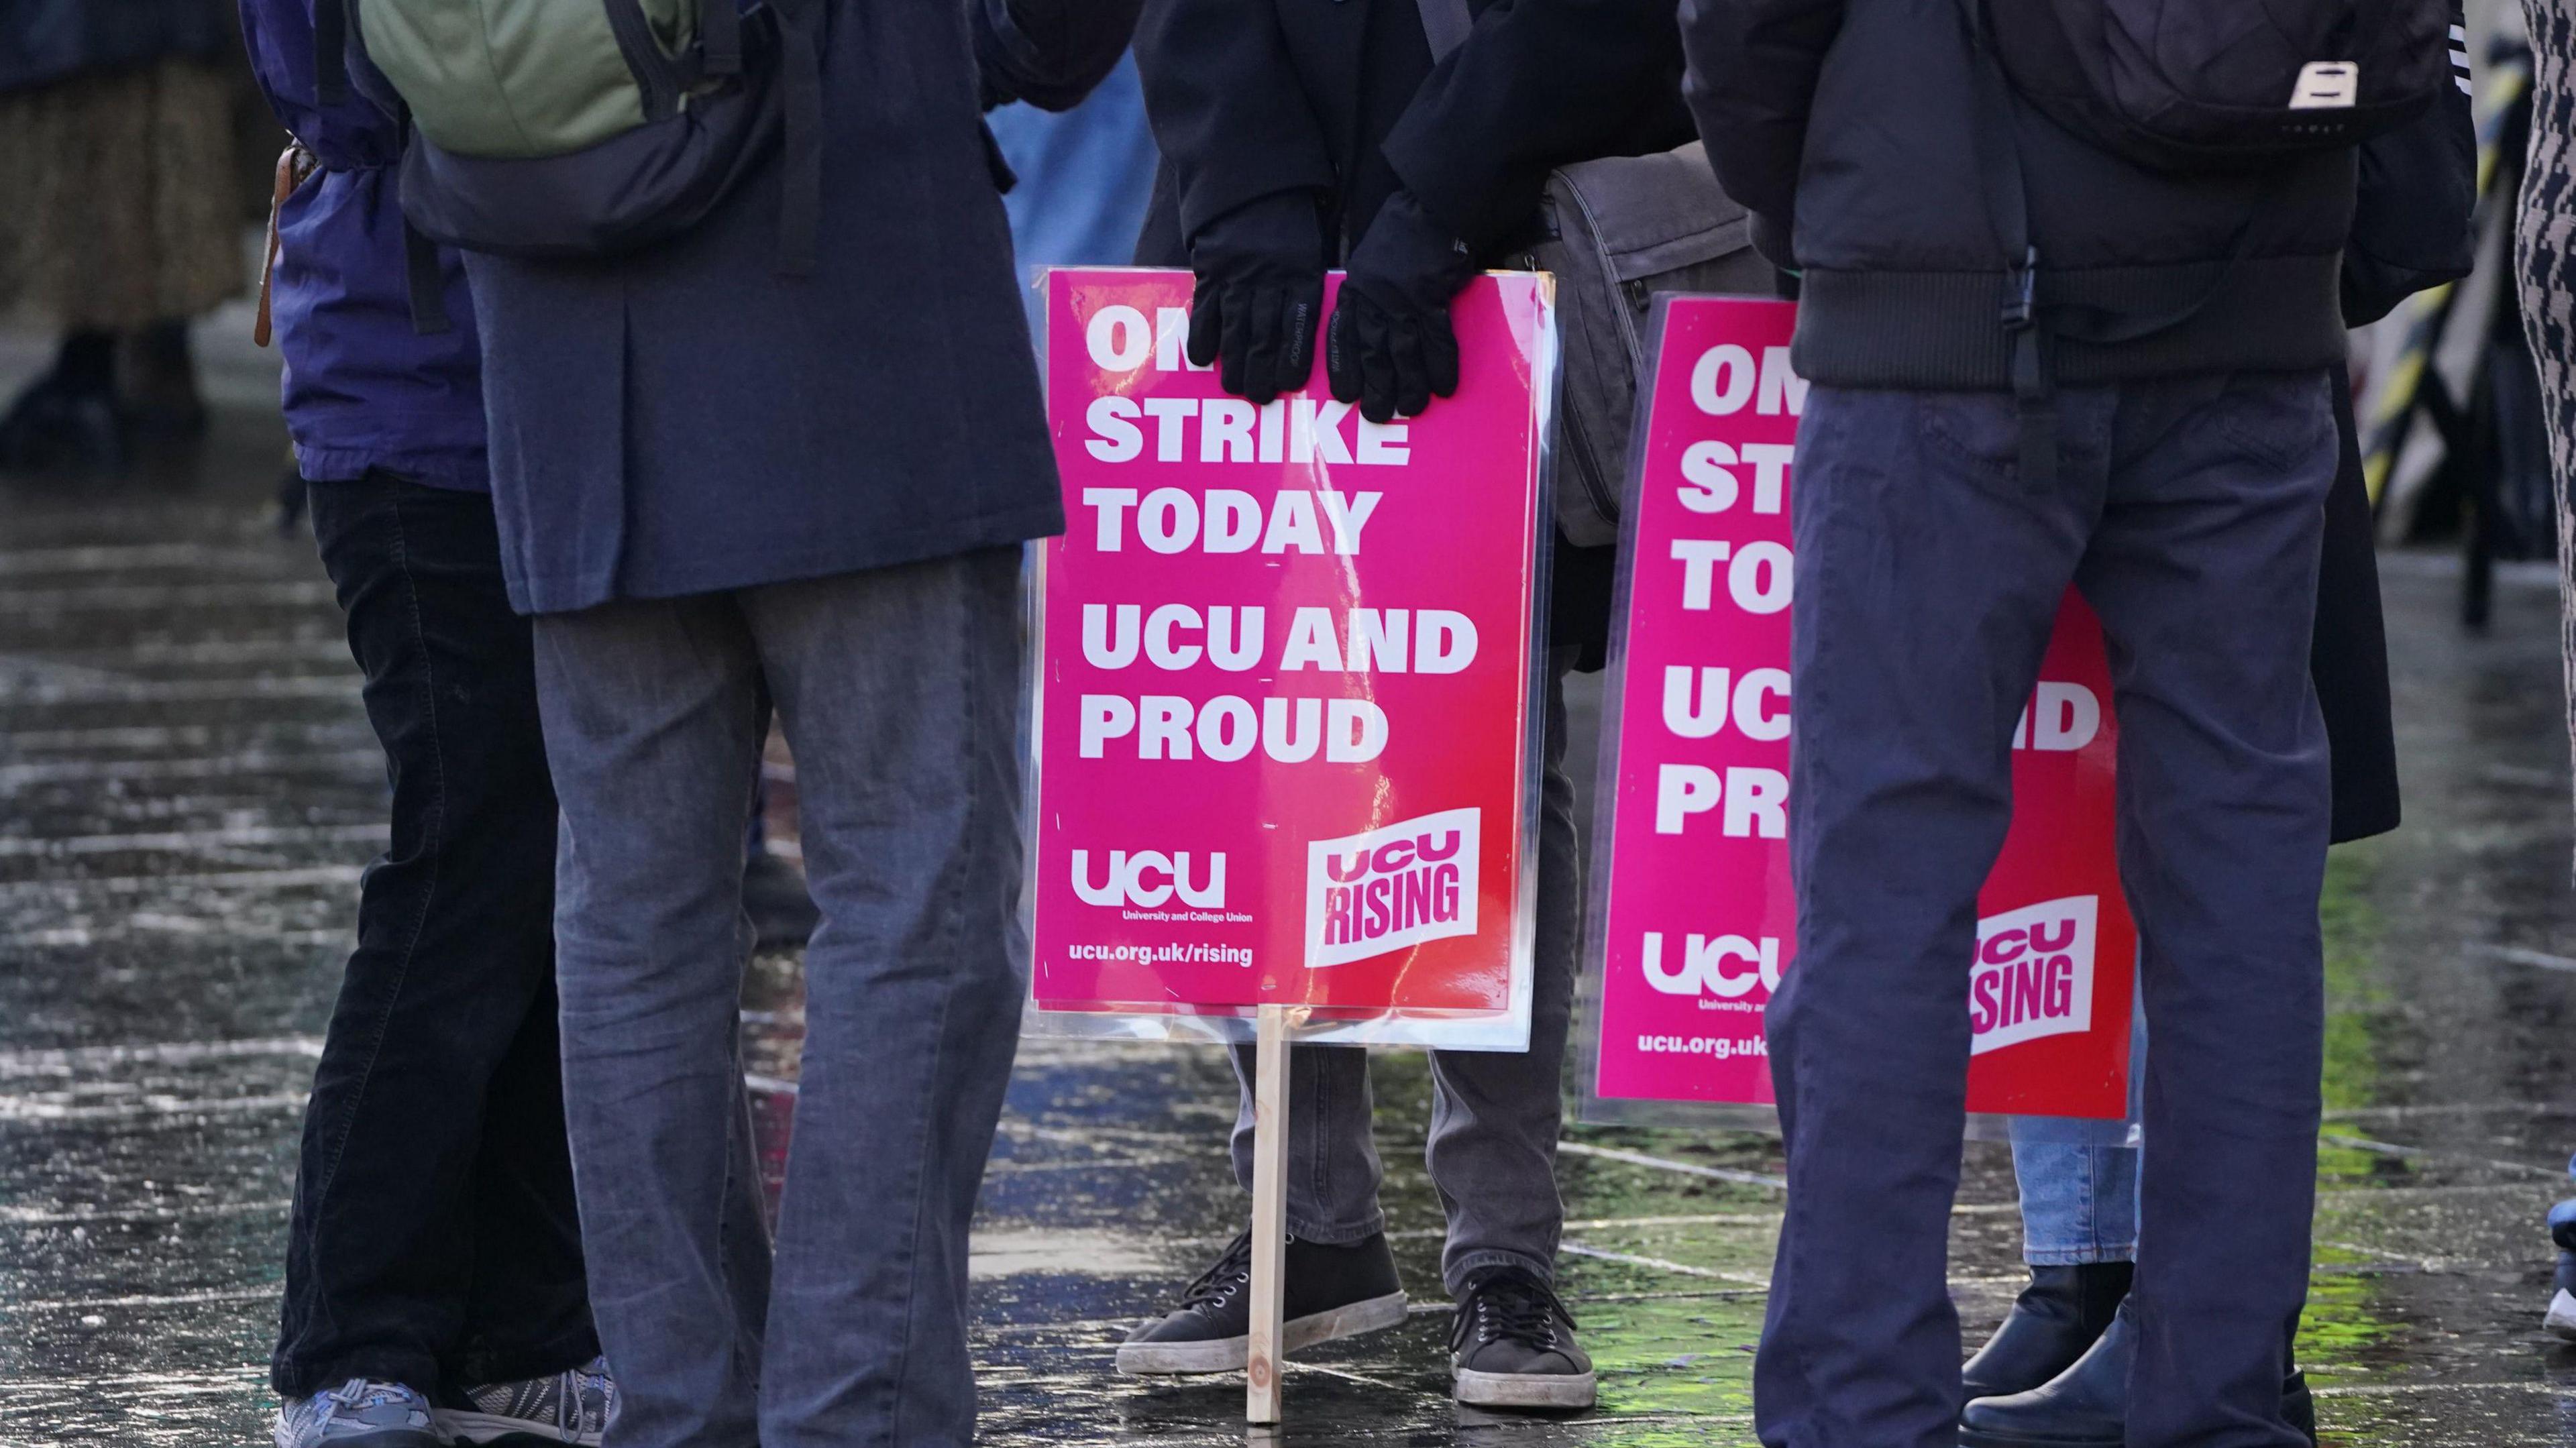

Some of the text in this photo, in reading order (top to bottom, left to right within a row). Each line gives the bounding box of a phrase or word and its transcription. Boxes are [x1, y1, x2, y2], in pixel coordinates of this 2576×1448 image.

[1086, 304, 1214, 372] ON
[1291, 303, 1307, 367] WATERPROOF
[1084, 396, 1411, 465] STRIKE
[1083, 487, 1383, 555] TODAY
[1082, 603, 1478, 674] UCU AND
[1079, 694, 1389, 763] PROUD
[1662, 665, 1791, 741] UC
[1071, 850, 1226, 908] UCU
[1328, 830, 1460, 883] UCU
[1122, 910, 1252, 923] University and College Union
[1325, 863, 1459, 945] RISING
[1069, 942, 1252, 967] ucu.org.uk/rising
[1699, 999, 1752, 1013] University
[1970, 954, 2072, 1035] SING
[1638, 1034, 1768, 1059] ucu.org.uk
